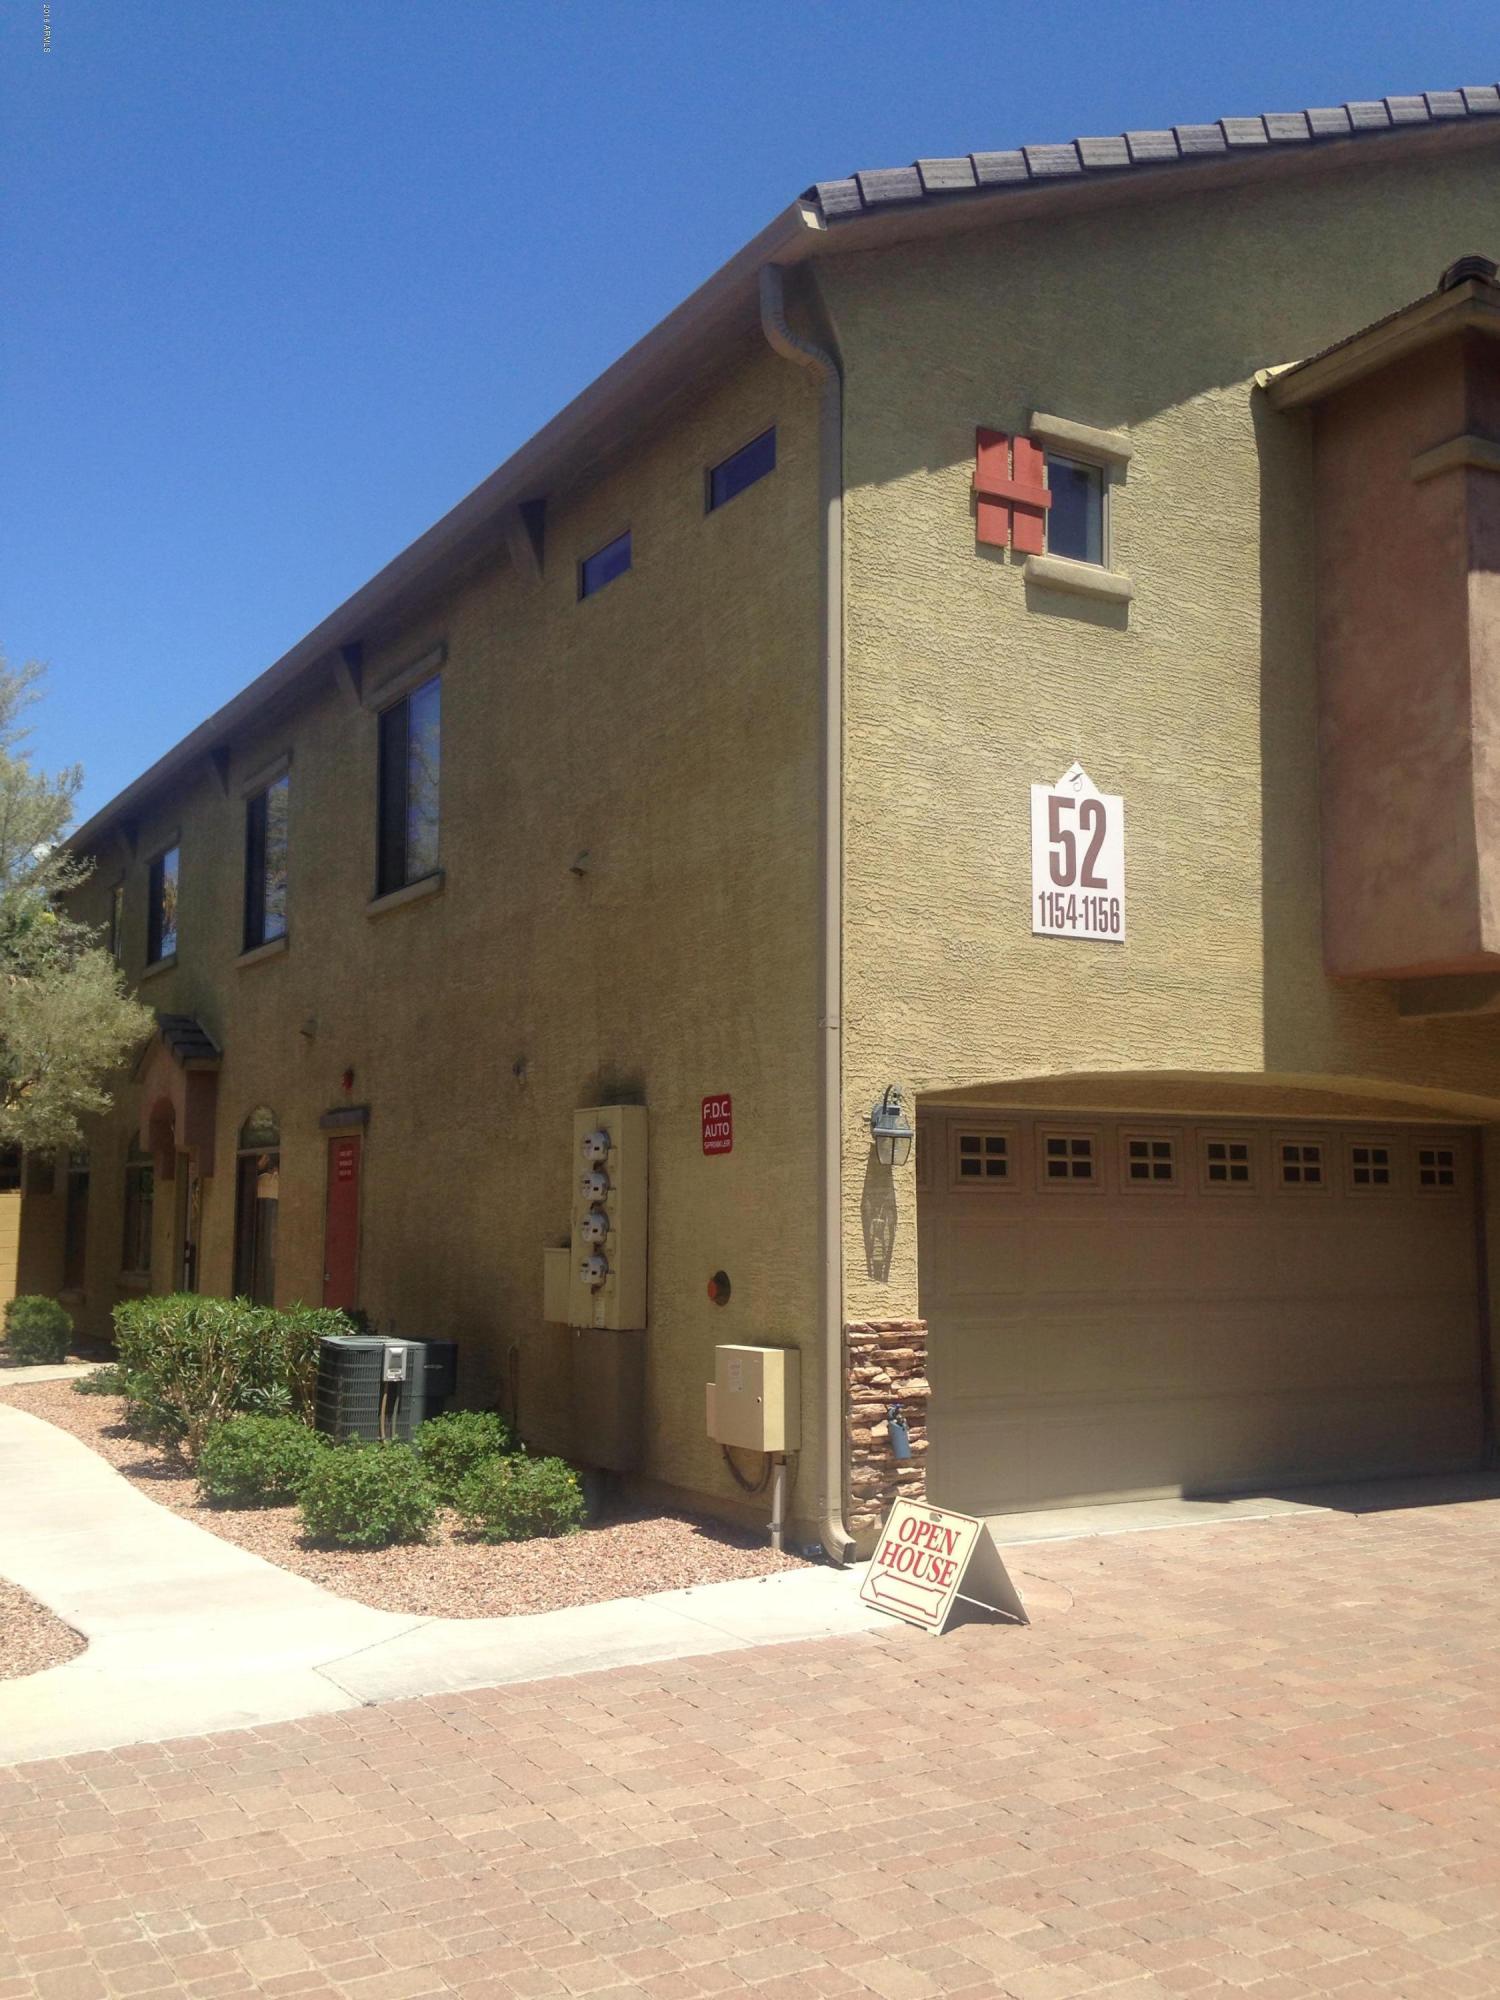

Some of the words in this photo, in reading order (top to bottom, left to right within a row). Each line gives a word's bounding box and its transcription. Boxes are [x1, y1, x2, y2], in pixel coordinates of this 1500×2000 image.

[1048, 795, 1107, 889] 52
[1039, 891, 1120, 933] 1154-1156
[704, 1122, 730, 1138] AUTO
[899, 1517, 961, 1555] OPEN
[878, 1541, 958, 1588] HOUSE
